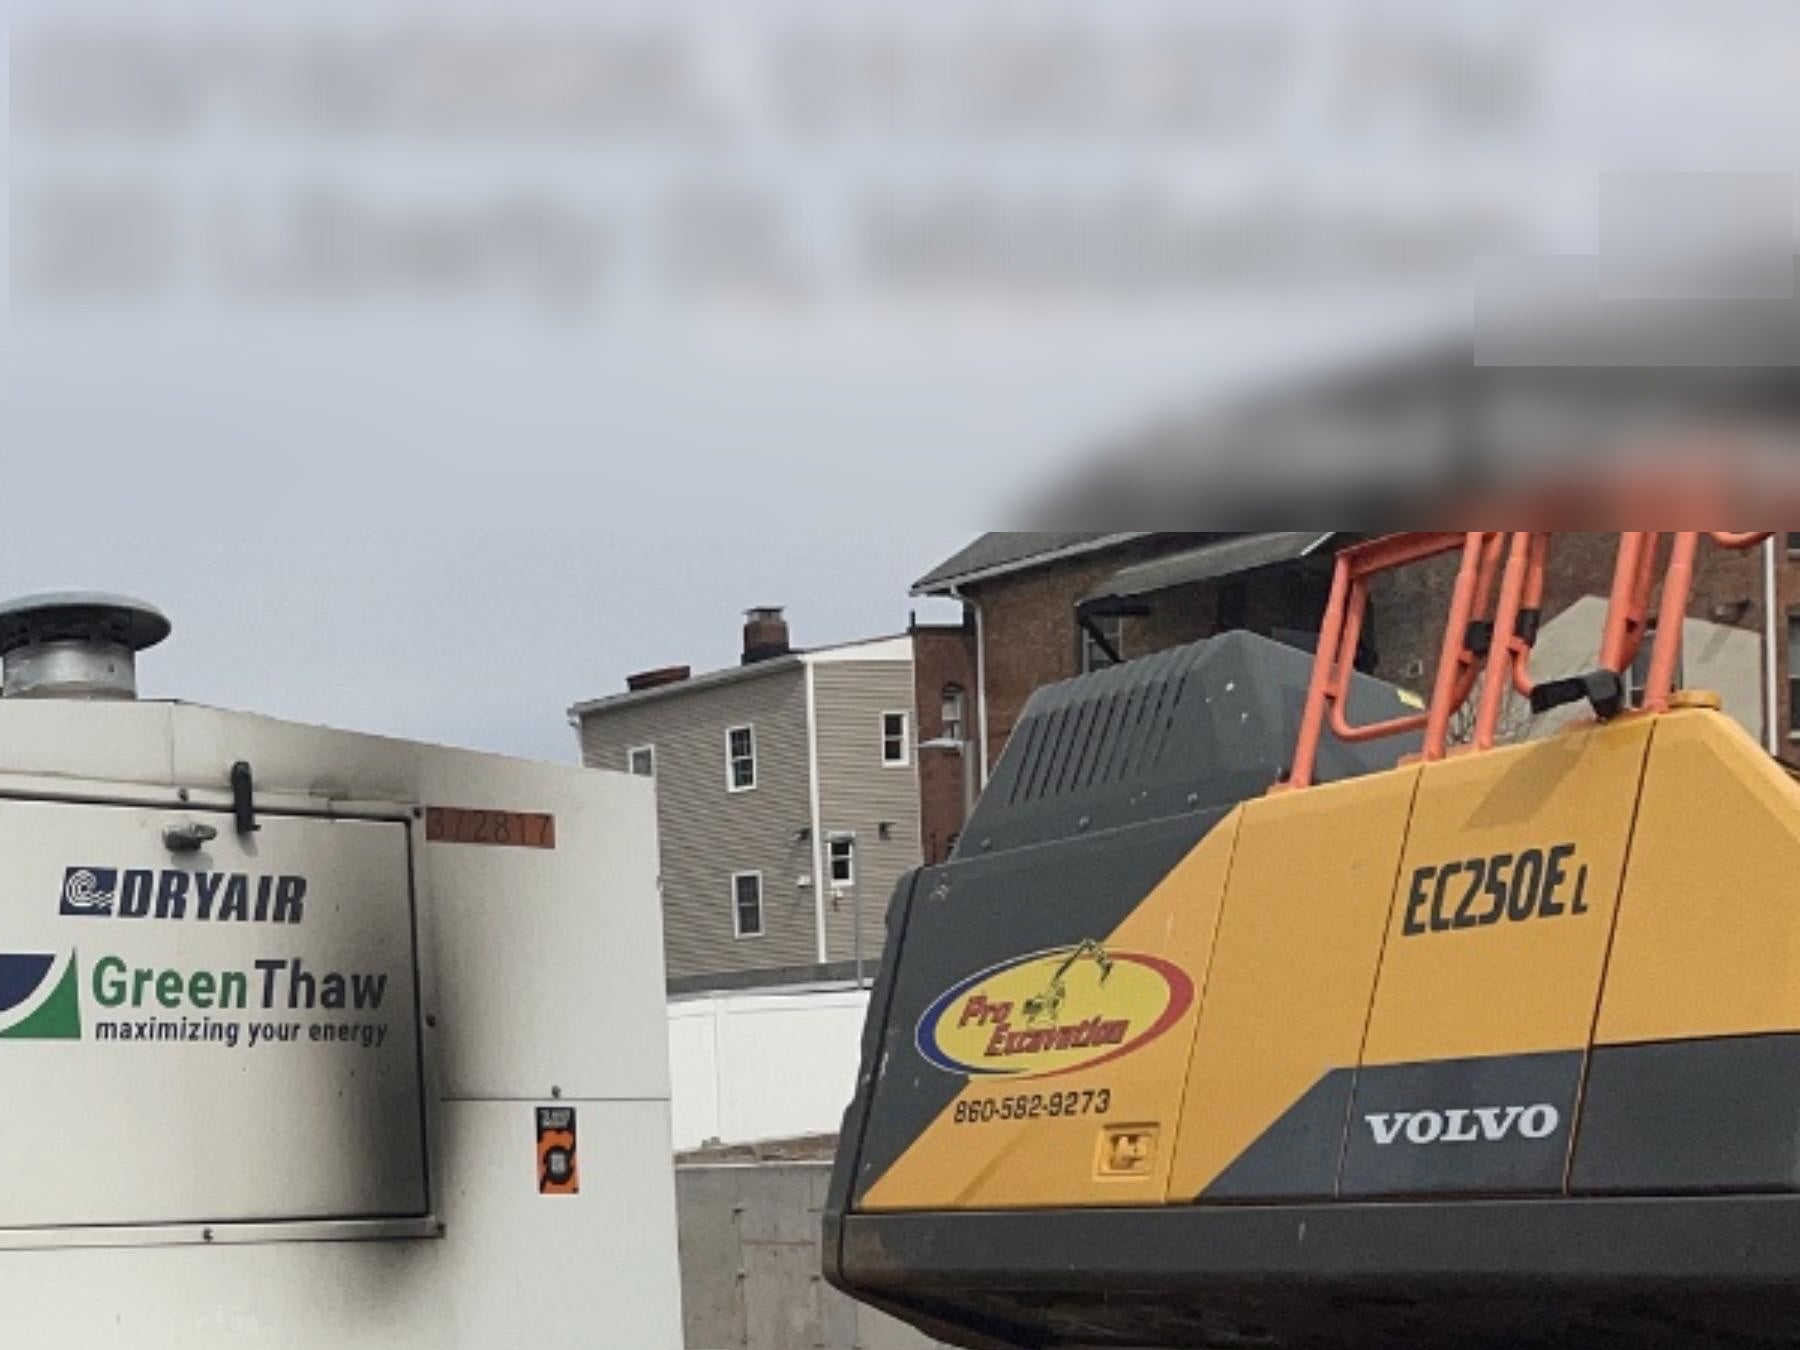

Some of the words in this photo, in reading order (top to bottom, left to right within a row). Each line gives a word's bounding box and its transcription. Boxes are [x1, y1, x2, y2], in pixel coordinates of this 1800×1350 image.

[116, 869, 307, 925] DRYAIR
[957, 993, 1014, 1029] Pro
[95, 1016, 239, 1046] maximizing
[248, 1020, 300, 1048] your
[308, 1020, 389, 1048] energy
[983, 1015, 1131, 1057] Excavation
[953, 1088, 1111, 1124] 860-582-9273
[1364, 1103, 1560, 1145] VOLVO
